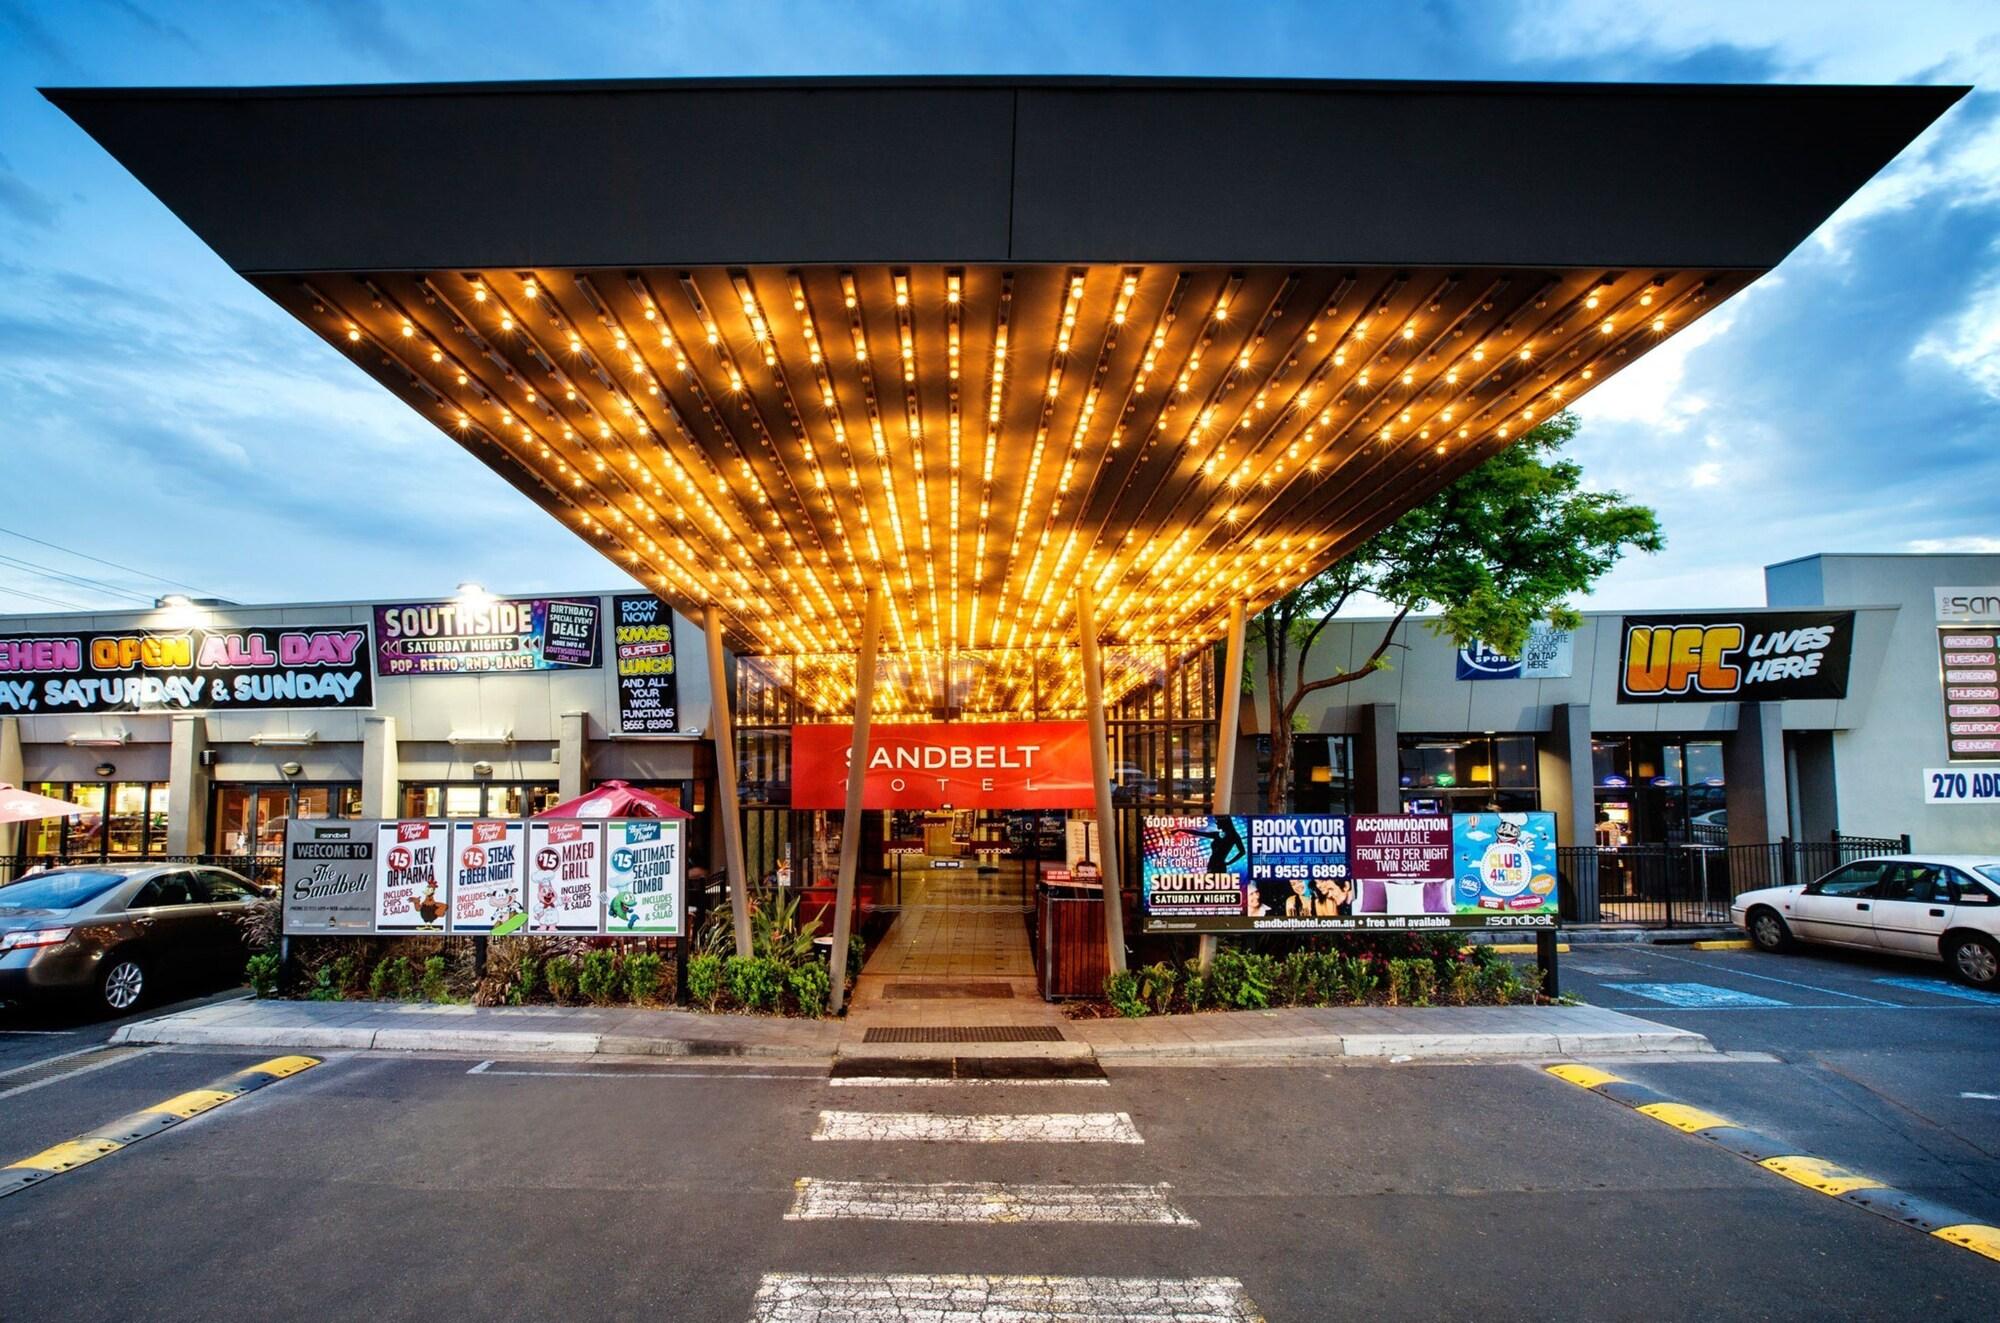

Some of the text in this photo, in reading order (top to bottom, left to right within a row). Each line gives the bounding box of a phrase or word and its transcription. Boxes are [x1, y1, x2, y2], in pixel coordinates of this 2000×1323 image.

[551, 604, 589, 617] BIRTHDAY
[622, 600, 658, 612] BOOK
[385, 604, 533, 637] SOUTHSIDE
[550, 614, 593, 625] SPECIAL EVENT
[623, 611, 656, 623] NOW
[552, 622, 588, 637] DEALS
[617, 626, 670, 643] XMAS
[407, 639, 513, 653] SATURDAY NIGHTS
[1528, 643, 1558, 652] SPORTS
[1747, 626, 1834, 657] LIVES
[1946, 638, 1990, 647] MONDAY
[92, 637, 192, 669] OPEN
[199, 636, 276, 668] ALL
[281, 632, 363, 666] DAY
[622, 643, 667, 657] BUFFET
[1527, 651, 1557, 661] ON TAP
[390, 655, 533, 673] POP RETRO RNB DANCE
[619, 656, 673, 674] LUNCH
[1527, 661, 1549, 669] HERE
[1626, 626, 1743, 693] UFC
[1947, 655, 1992, 664] TUESDAY
[1745, 653, 1823, 684] HERE
[622, 677, 668, 688] AND ALL
[45, 676, 205, 708] SATURDAY
[212, 679, 230, 700] &
[234, 671, 362, 702] SUNDAY
[631, 688, 660, 698] YOUR
[1950, 689, 1997, 698] THURSDAY
[630, 698, 661, 709] WORK
[623, 708, 675, 719] FUNCTIONS
[1956, 706, 1993, 716] FRIDAY
[623, 720, 645, 730] 9555
[1951, 723, 1999, 733] SATURDAY
[1957, 741, 1997, 751] SUNDAY
[845, 778, 1039, 792] OTEL
[1932, 773, 1967, 799] 270
[1146, 816, 1209, 828] GOOD TIMES
[1253, 819, 1345, 836] BOOK YOUR
[1356, 819, 1448, 831] ACCOMMODATION
[1158, 837, 1200, 847] ARE JUST
[1252, 836, 1346, 853] FUNCTION
[1374, 832, 1430, 845] AVAILABLE
[297, 844, 367, 859] WELCOME TO
[390, 846, 436, 867] $15 KIEV
[464, 845, 515, 866] $15 STEAK
[538, 842, 594, 868] $15 MIXED
[614, 844, 675, 868] $15 ULTIMATE
[1161, 847, 1197, 857] AROUND
[1357, 848, 1448, 861] FROM $79 PER NIGHT
[1152, 859, 1168, 868] THE
[1376, 860, 1430, 872] TWIN SHARE
[1490, 854, 1522, 868] CLUB
[313, 864, 336, 883] The
[460, 862, 515, 886] & BEER NIGHT
[562, 861, 589, 880] GRILL
[632, 860, 670, 879] SEAFOOD
[1253, 864, 1346, 878] PH 9555 6899
[1490, 868, 1524, 881] 4KIDS
[387, 865, 435, 887] OR PARMA
[1151, 872, 1241, 891] SOUTHSIDE
[293, 873, 370, 901] Sandbelt
[561, 884, 591, 895] INCLUDES
[633, 877, 663, 894] COMBO
[384, 888, 413, 899] INCLUDES
[457, 892, 487, 903] INCLUDES
[572, 892, 591, 902] CHIPS
[642, 893, 672, 905] INCLUDES
[1155, 894, 1237, 904] SATURDAY NIGHTS
[383, 899, 401, 908] CHIPS
[457, 903, 475, 912] CHIPS
[564, 900, 592, 911] & SALAD
[653, 903, 672, 911] CHIPS
[390, 905, 410, 915] SALAD
[464, 909, 484, 919] SALAD
[645, 910, 673, 921] & SALAD
[1254, 917, 1451, 929] sandbelthotel.com.au free wifi available
[1491, 914, 1554, 926] sandbelt
